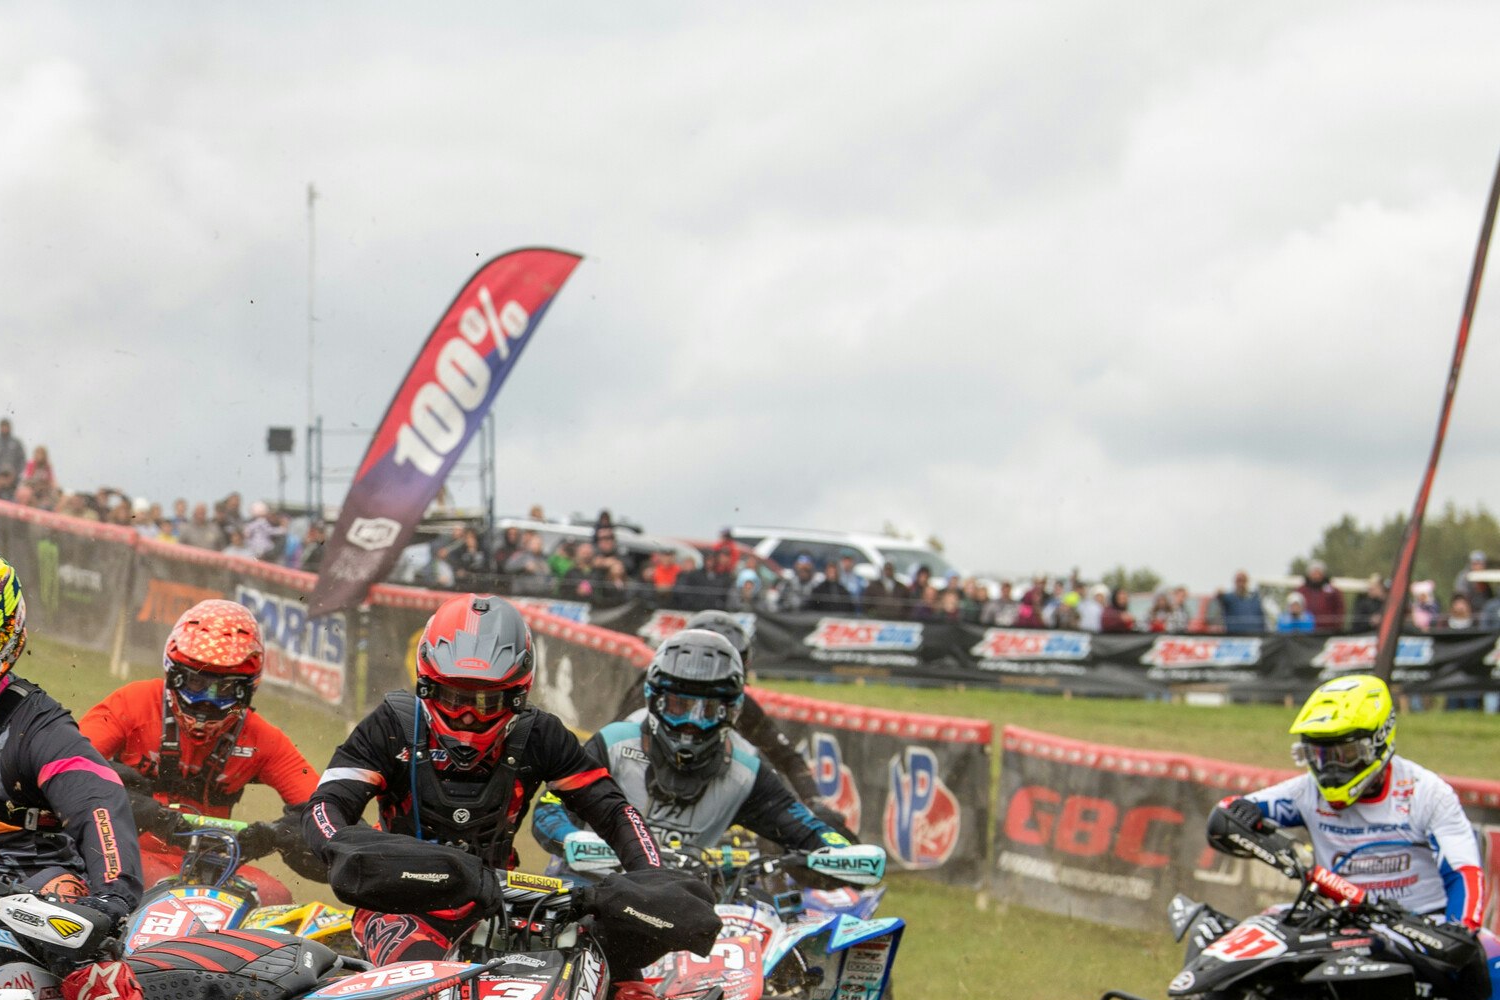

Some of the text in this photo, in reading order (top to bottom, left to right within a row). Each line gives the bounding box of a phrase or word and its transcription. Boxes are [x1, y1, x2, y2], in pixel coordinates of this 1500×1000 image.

[392, 285, 530, 477] 100%
[816, 619, 922, 650] AMSOIL
[982, 629, 1091, 660] AMSOIL
[1151, 638, 1262, 667] AMSOIL
[1005, 785, 1186, 868] GBC
[1315, 866, 1359, 899] Mika
[363, 962, 435, 988] 733
